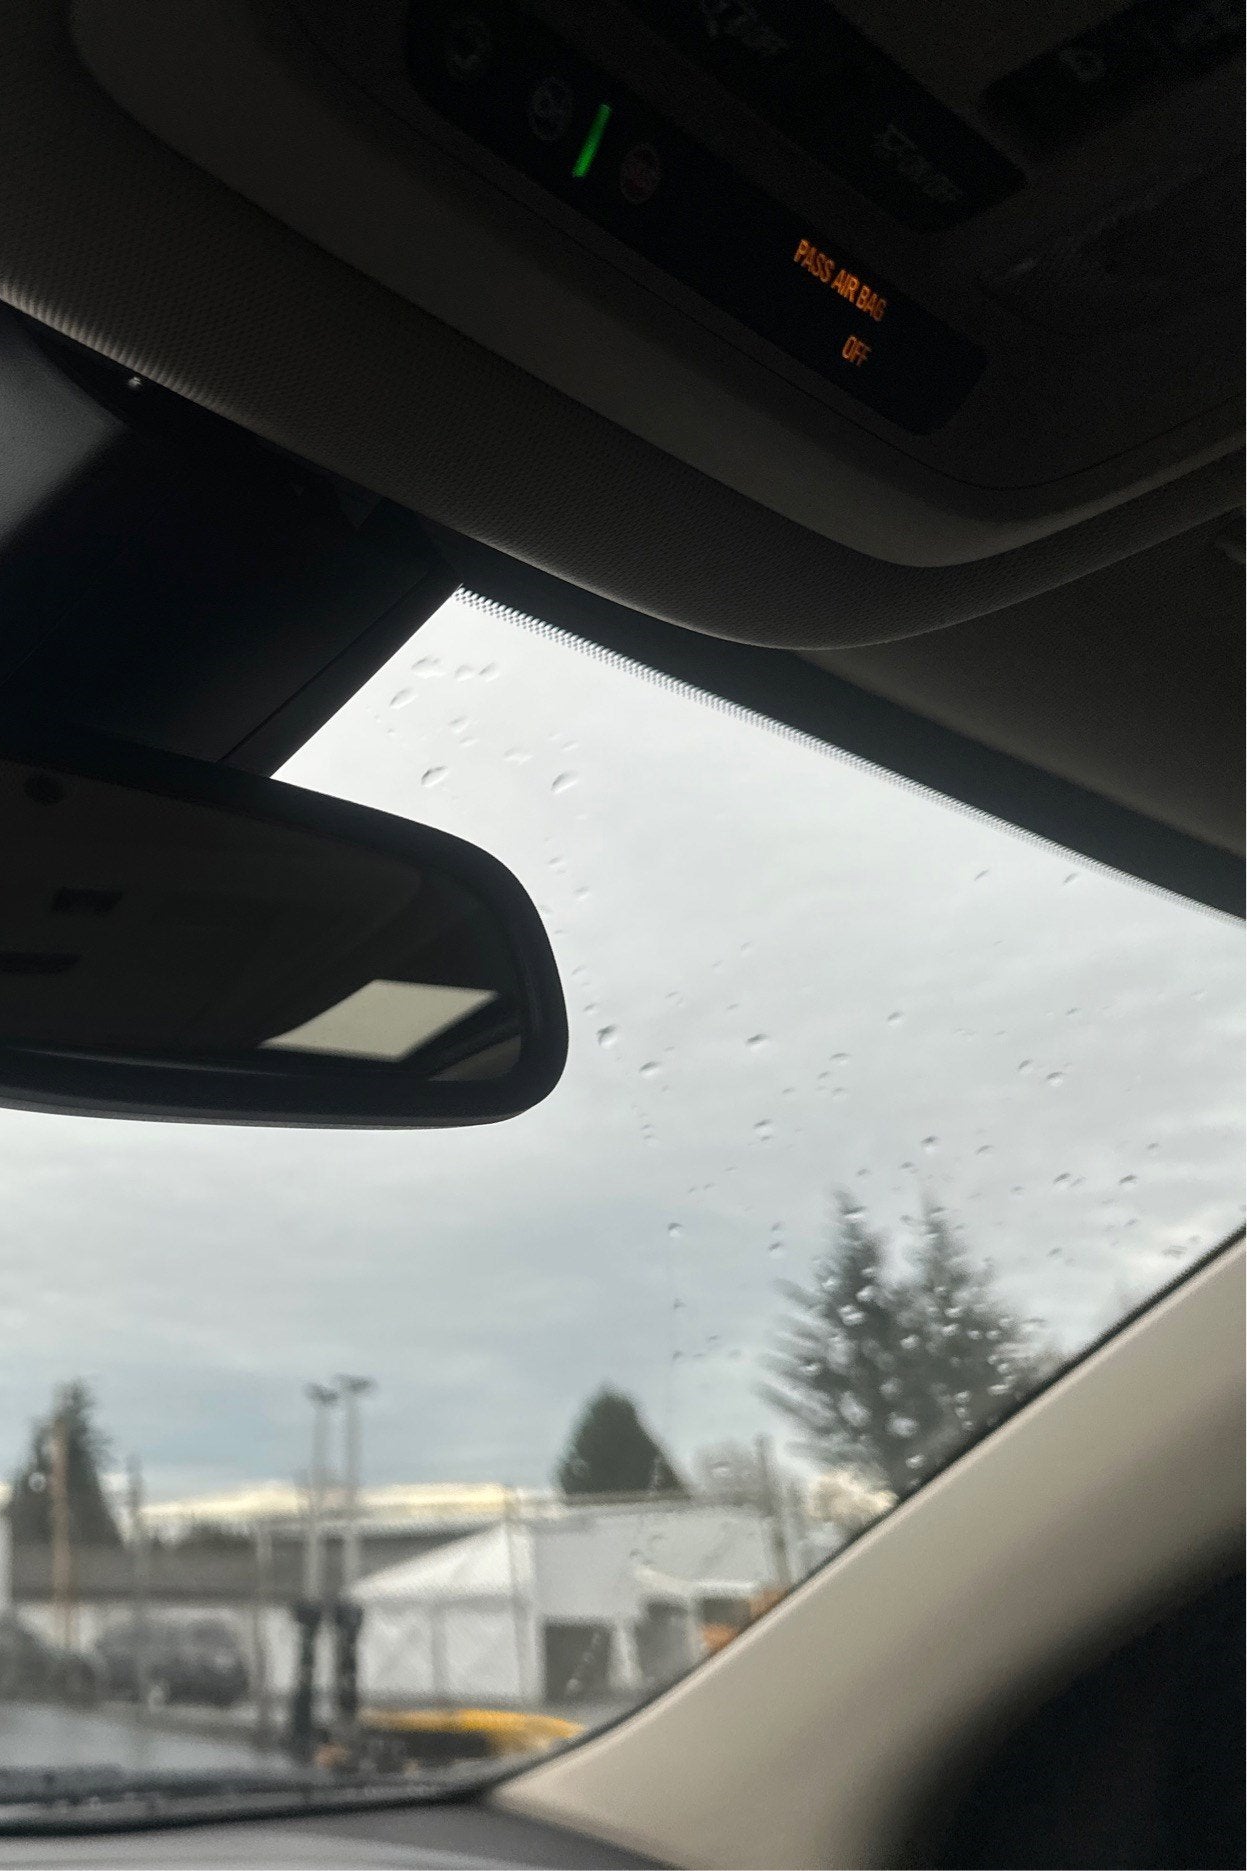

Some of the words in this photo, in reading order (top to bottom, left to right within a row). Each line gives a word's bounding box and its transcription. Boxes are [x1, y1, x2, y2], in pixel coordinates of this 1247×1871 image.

[793, 239, 836, 283] PASS
[830, 269, 860, 303] AIR
[855, 285, 887, 322] BAG
[841, 336, 872, 368] OFF
